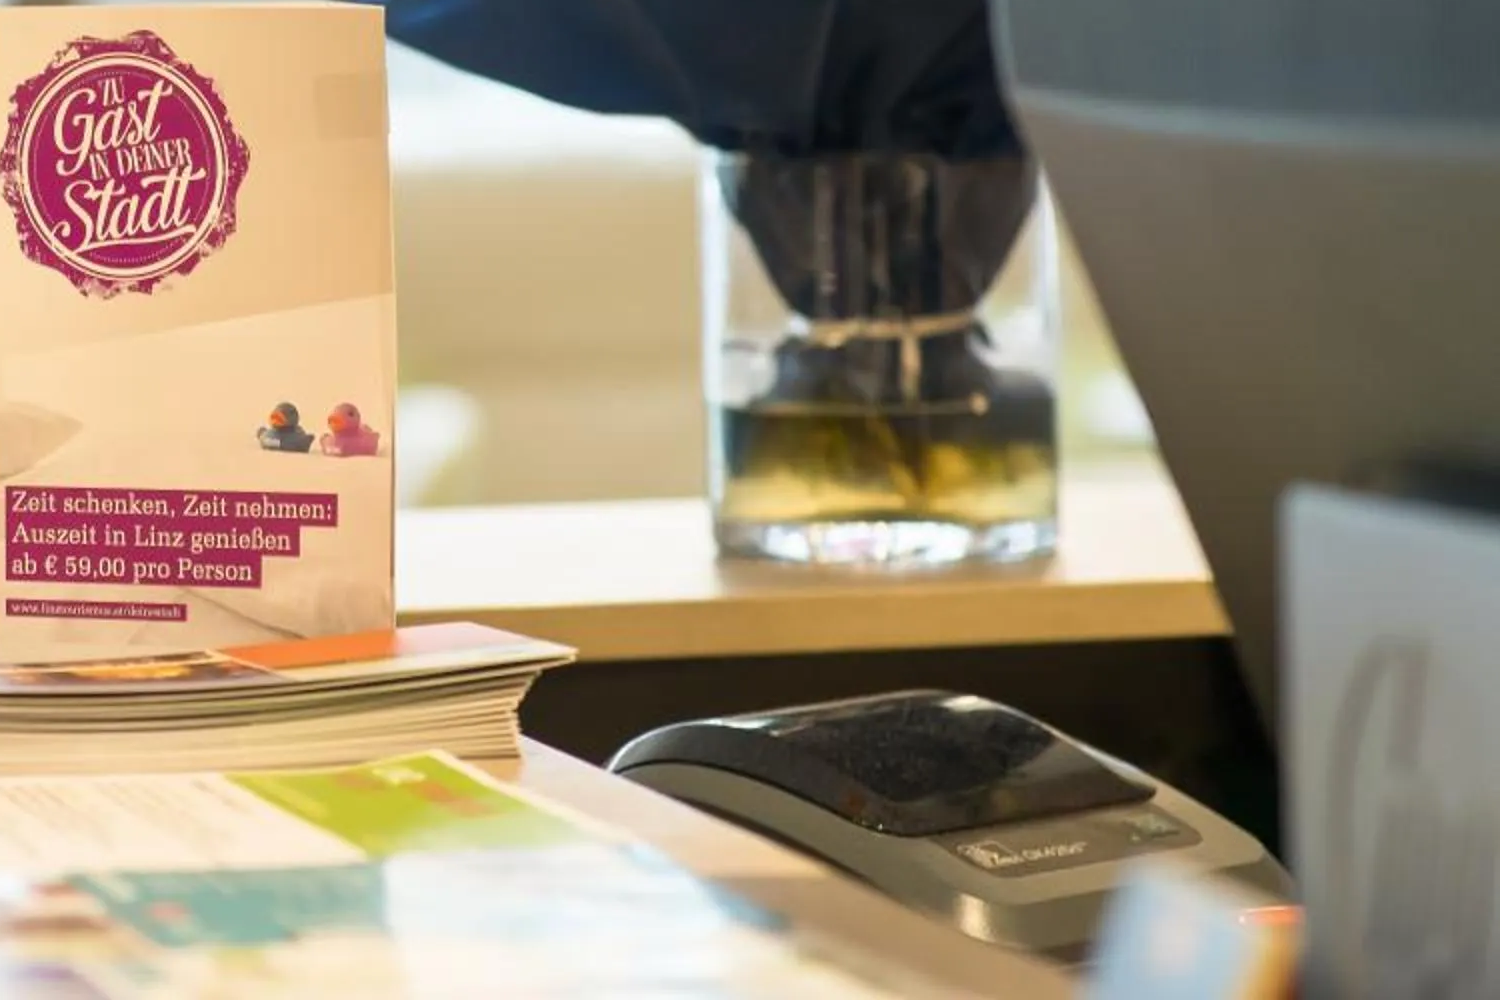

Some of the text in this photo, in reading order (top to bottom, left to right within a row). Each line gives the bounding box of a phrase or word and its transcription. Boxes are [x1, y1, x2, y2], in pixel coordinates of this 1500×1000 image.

[53, 79, 173, 176] Gast
[89, 137, 193, 180] IN DEINER
[52, 166, 206, 250] Stadt
[11, 490, 332, 520] Zeit schenken, Zeit nehmen:
[11, 522, 292, 554] Auszeit in Linz genießen
[11, 551, 253, 584] ab € 59,00 pro Person
